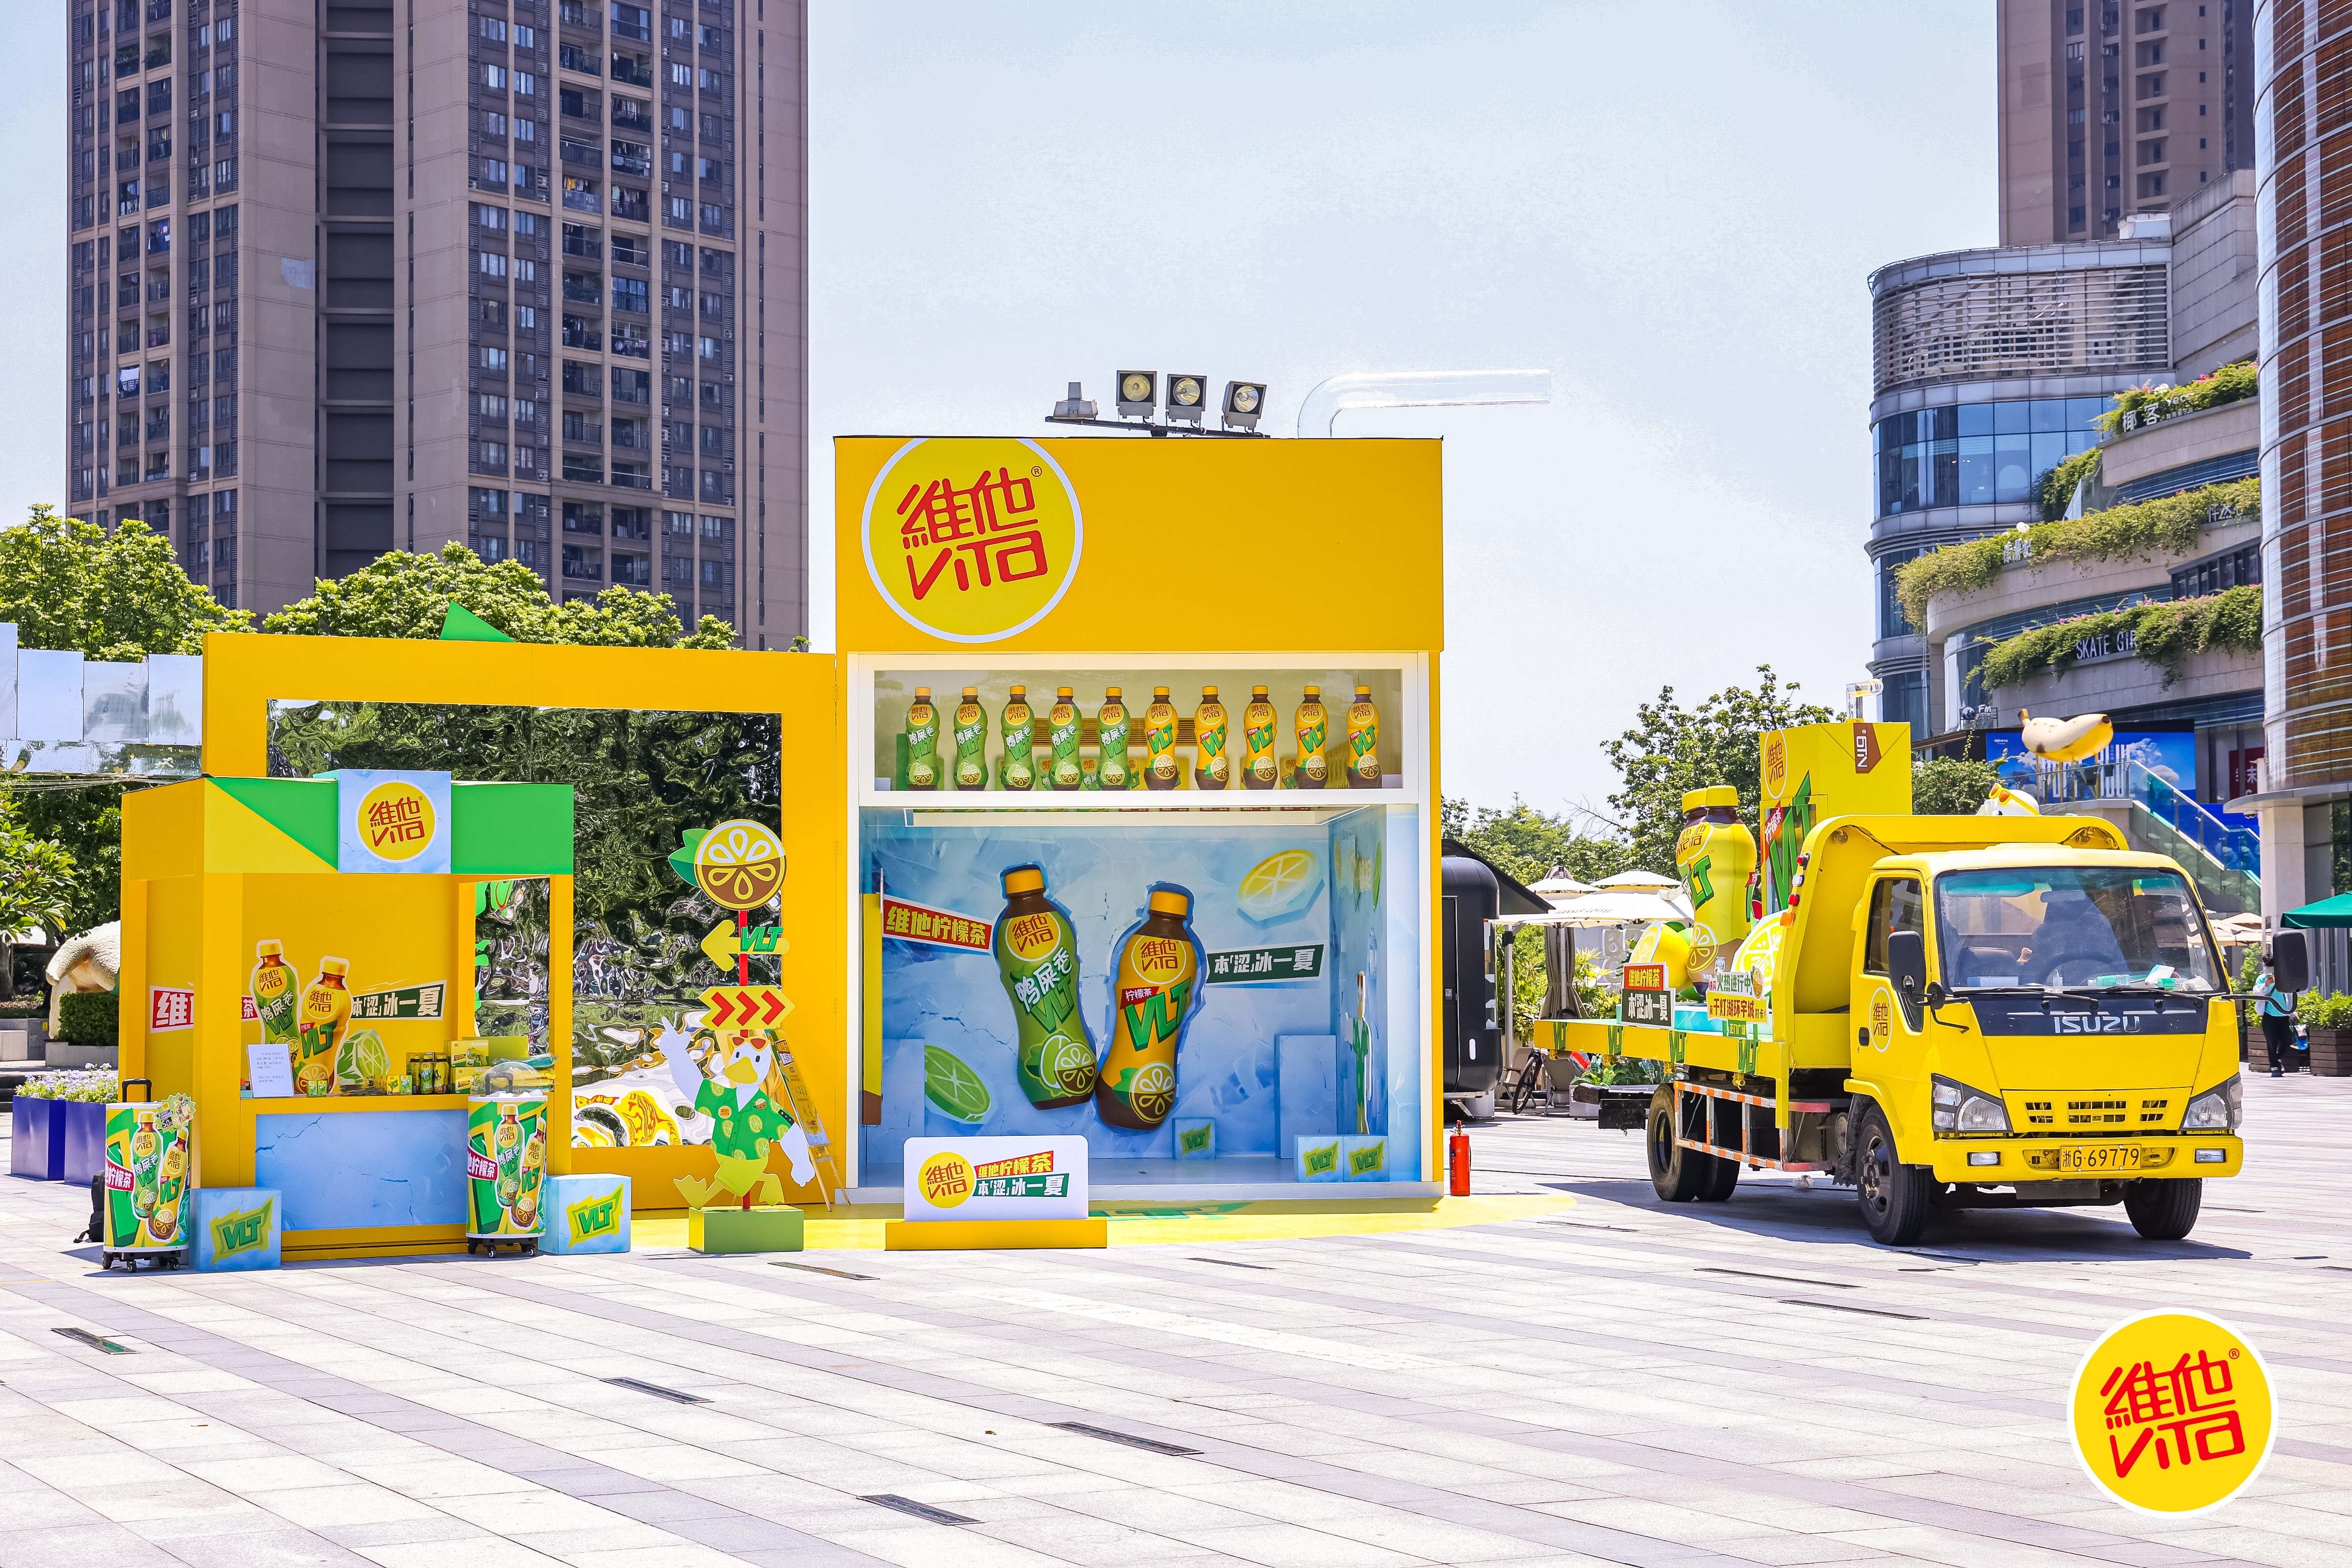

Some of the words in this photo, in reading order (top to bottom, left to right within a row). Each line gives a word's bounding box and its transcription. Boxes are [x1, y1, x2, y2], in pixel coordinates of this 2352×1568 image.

[2123, 402, 2160, 433] 椰客
[896, 466, 1038, 549] 維他
[2076, 635, 2109, 660] SKATE
[2117, 630, 2138, 652] GIR
[909, 725, 935, 747] 鸭屎香
[956, 723, 981, 746] 鸭屎香
[1006, 725, 1031, 750] 鸭屎香
[1052, 723, 1076, 748] 鸭屎香
[1101, 723, 1127, 747] 鸭屎香
[368, 797, 421, 828] 維他
[1764, 807, 1782, 845] 柠檬茶
[886, 906, 986, 946] 维他柠檬茶
[1012, 914, 1048, 940] 維他
[740, 926, 784, 953] VLT
[1140, 939, 1176, 958] 維他
[1214, 949, 1315, 974] 本「涩」冰一夏
[1015, 947, 1072, 1012] 鸭屎香
[1628, 968, 1660, 988] 维他柠檬茶
[261, 990, 294, 1022] 鸭屎香
[1125, 988, 1152, 1002] 柠檬茶
[1628, 993, 1668, 1021] 本「涩」冰一夏
[1125, 977, 1191, 1052] VLT
[2054, 1016, 2140, 1033] ISUZU
[301, 1020, 338, 1059] VLT
[1729, 1024, 1745, 1036] 正门广场
[498, 1144, 520, 1164] 鸭屎香
[1185, 1132, 1205, 1151] VLT
[135, 1152, 158, 1175] 鸭屎香
[926, 1161, 964, 1185] 維他
[978, 1153, 1053, 1178] 维他柠檬茶
[1310, 1151, 1332, 1171] VLT
[1356, 1151, 1377, 1171] VLT
[160, 1176, 182, 1204] VLT
[522, 1166, 540, 1194] VLT
[978, 1176, 1063, 1197] 本「涩」冰一夏
[578, 1201, 613, 1234] VLT
[223, 1216, 261, 1250] VLT
